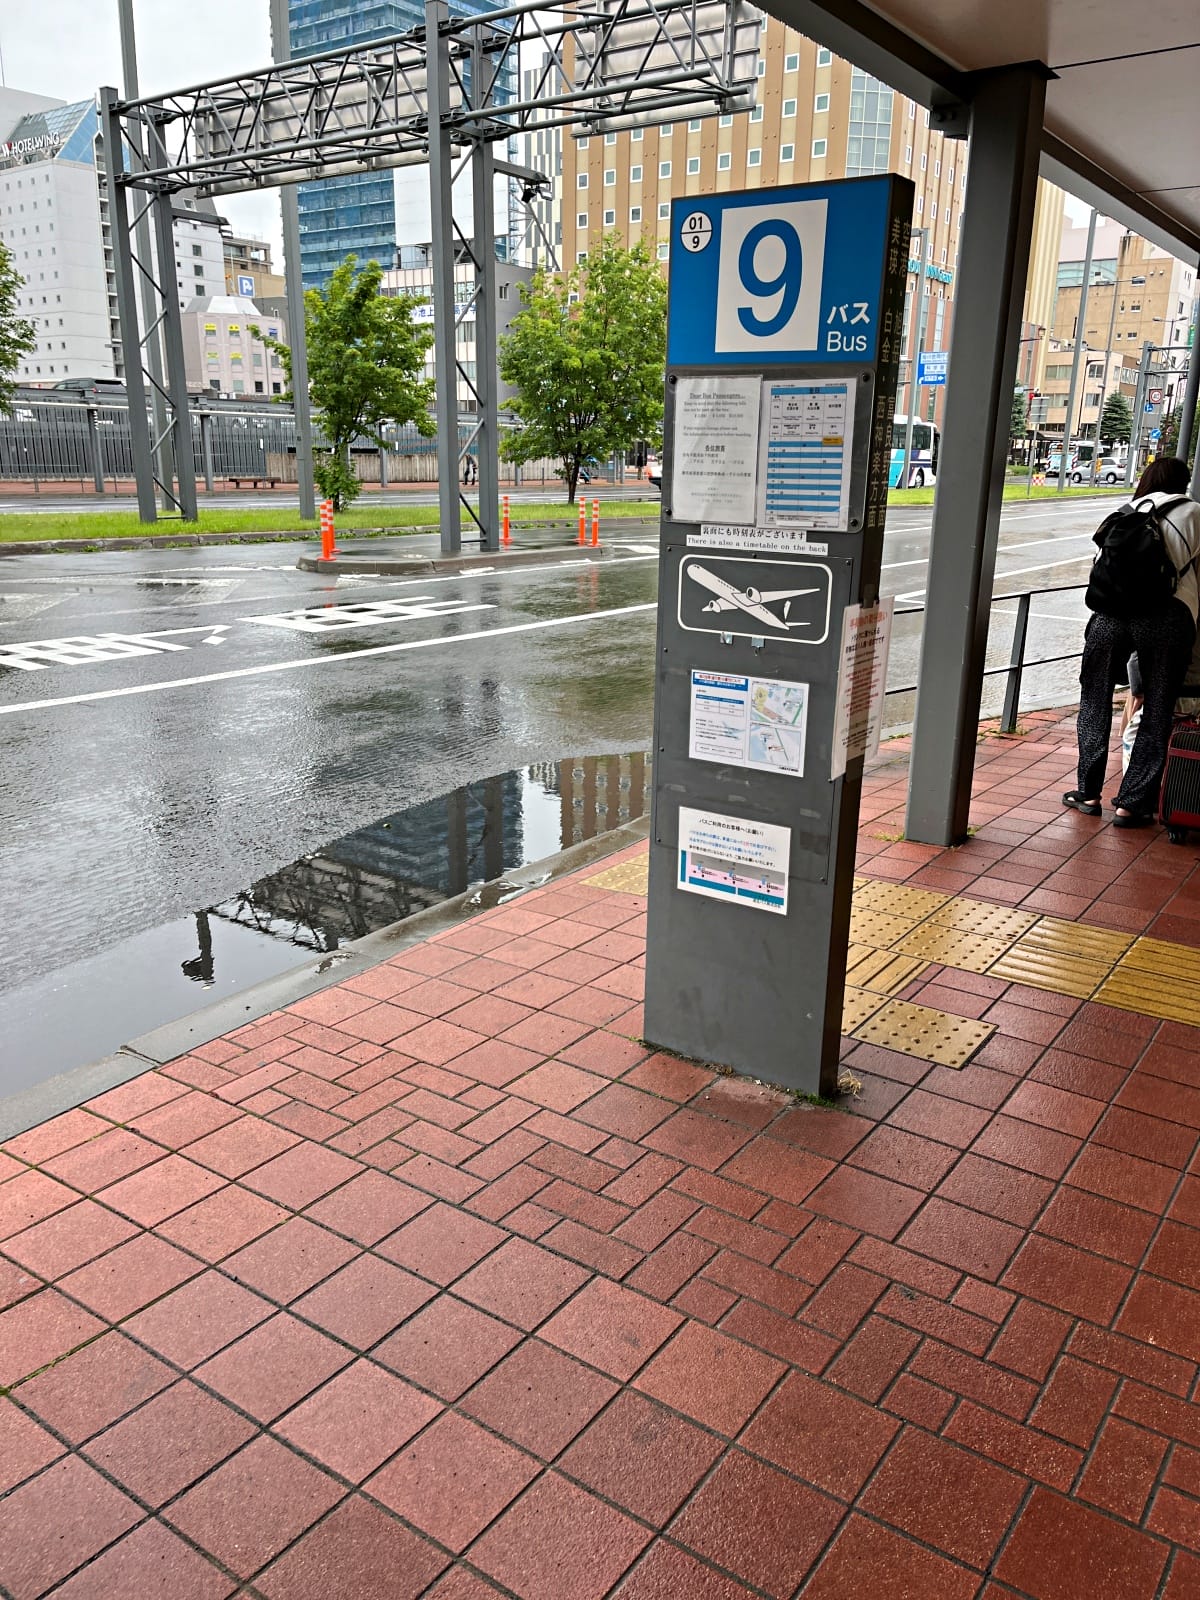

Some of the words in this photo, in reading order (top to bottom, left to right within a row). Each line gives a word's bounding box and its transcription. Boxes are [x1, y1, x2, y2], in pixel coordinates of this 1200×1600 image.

[689, 216, 704, 231] 01
[692, 235, 700, 249] 9
[737, 218, 803, 337] 9
[242, 279, 251, 293] P
[827, 302, 870, 325] バス
[826, 331, 867, 352] Bus
[702, 527, 806, 541] 裏面にも時刻表がございます
[687, 537, 707, 545] There
[743, 540, 778, 549] timetable
[793, 543, 806, 551] the
[809, 544, 827, 552] back
